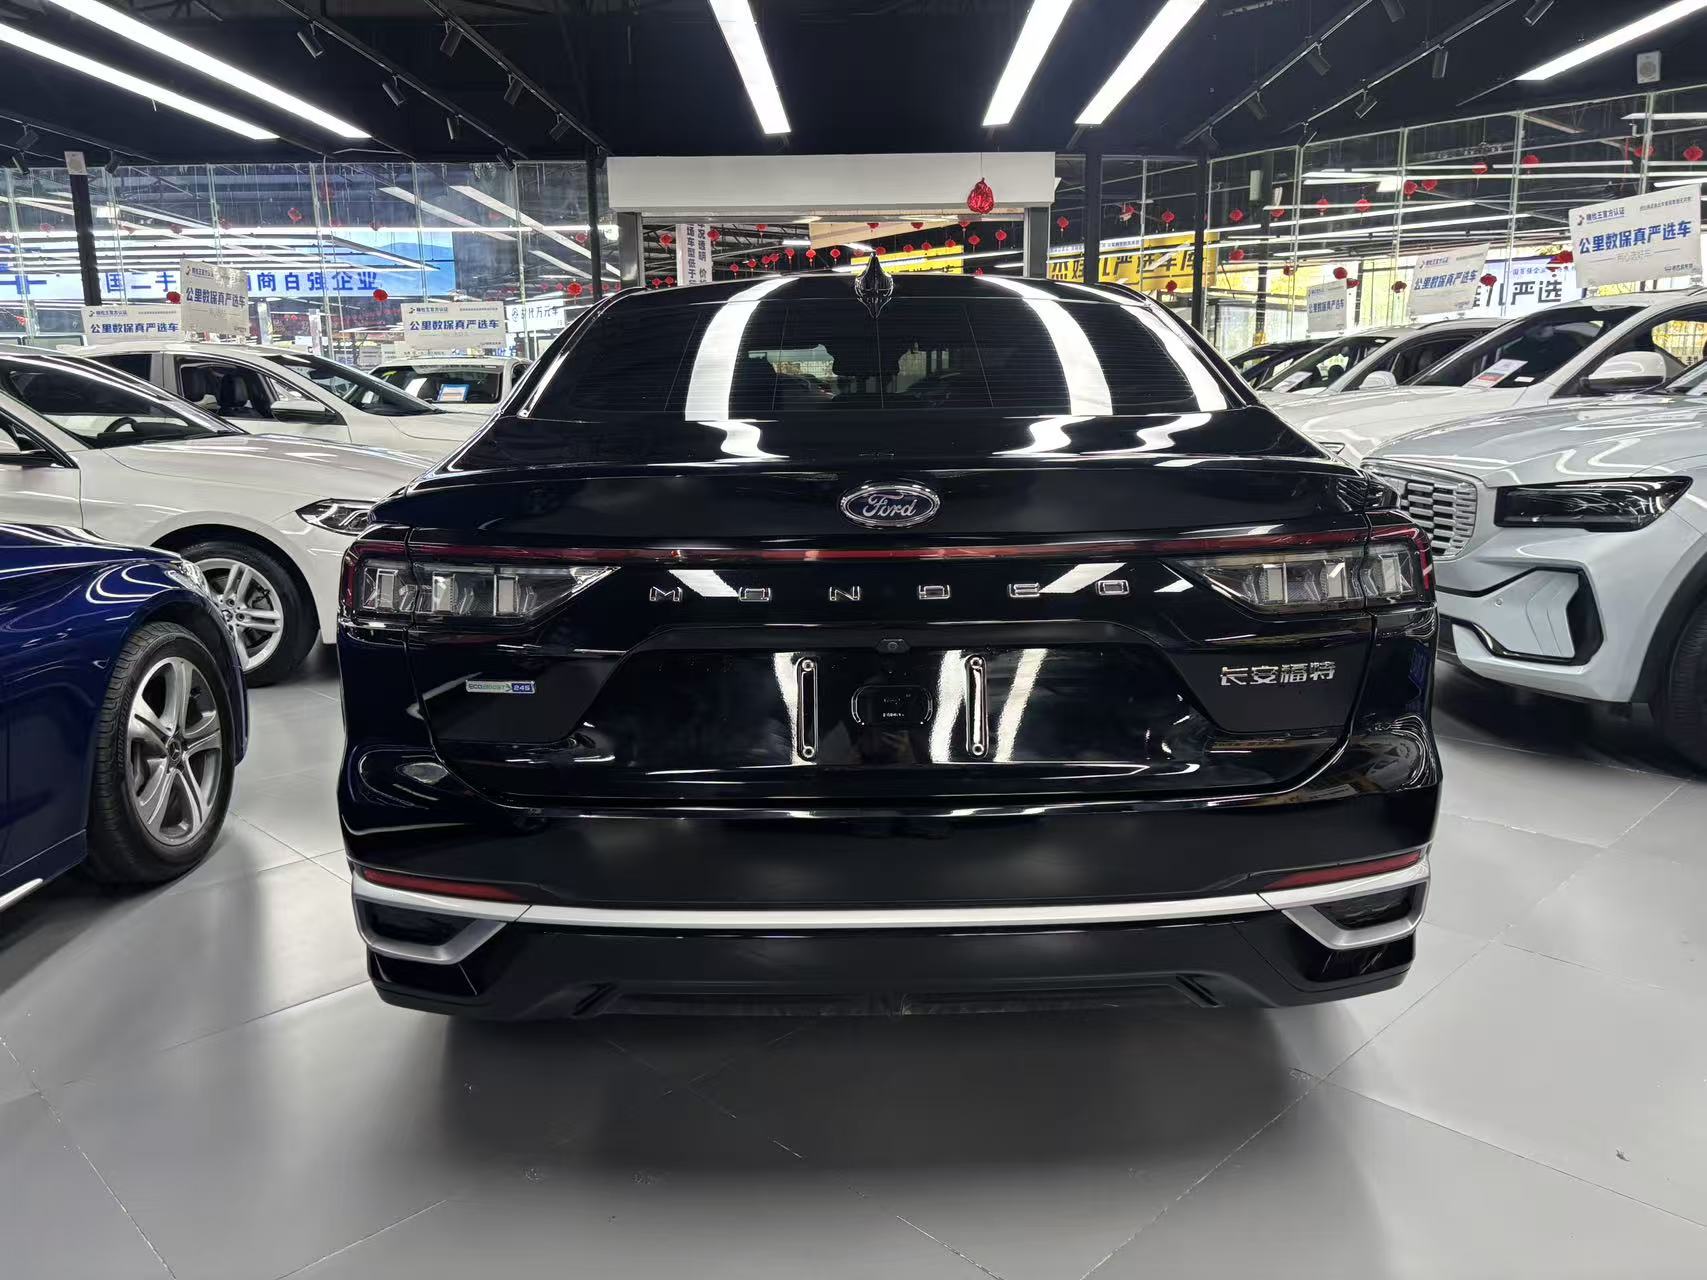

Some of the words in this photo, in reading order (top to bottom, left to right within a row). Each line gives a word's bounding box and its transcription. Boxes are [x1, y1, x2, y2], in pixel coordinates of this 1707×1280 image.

[1579, 220, 1692, 254] 公里数保真严选车
[185, 287, 245, 309] 公里数保真严选车
[90, 323, 179, 334] 公里数保真严选车
[410, 319, 499, 331] 公里数保真严选车
[862, 492, 919, 517] Ford
[649, 579, 1130, 602] MONDEO
[1220, 661, 1336, 686] 长安福特
